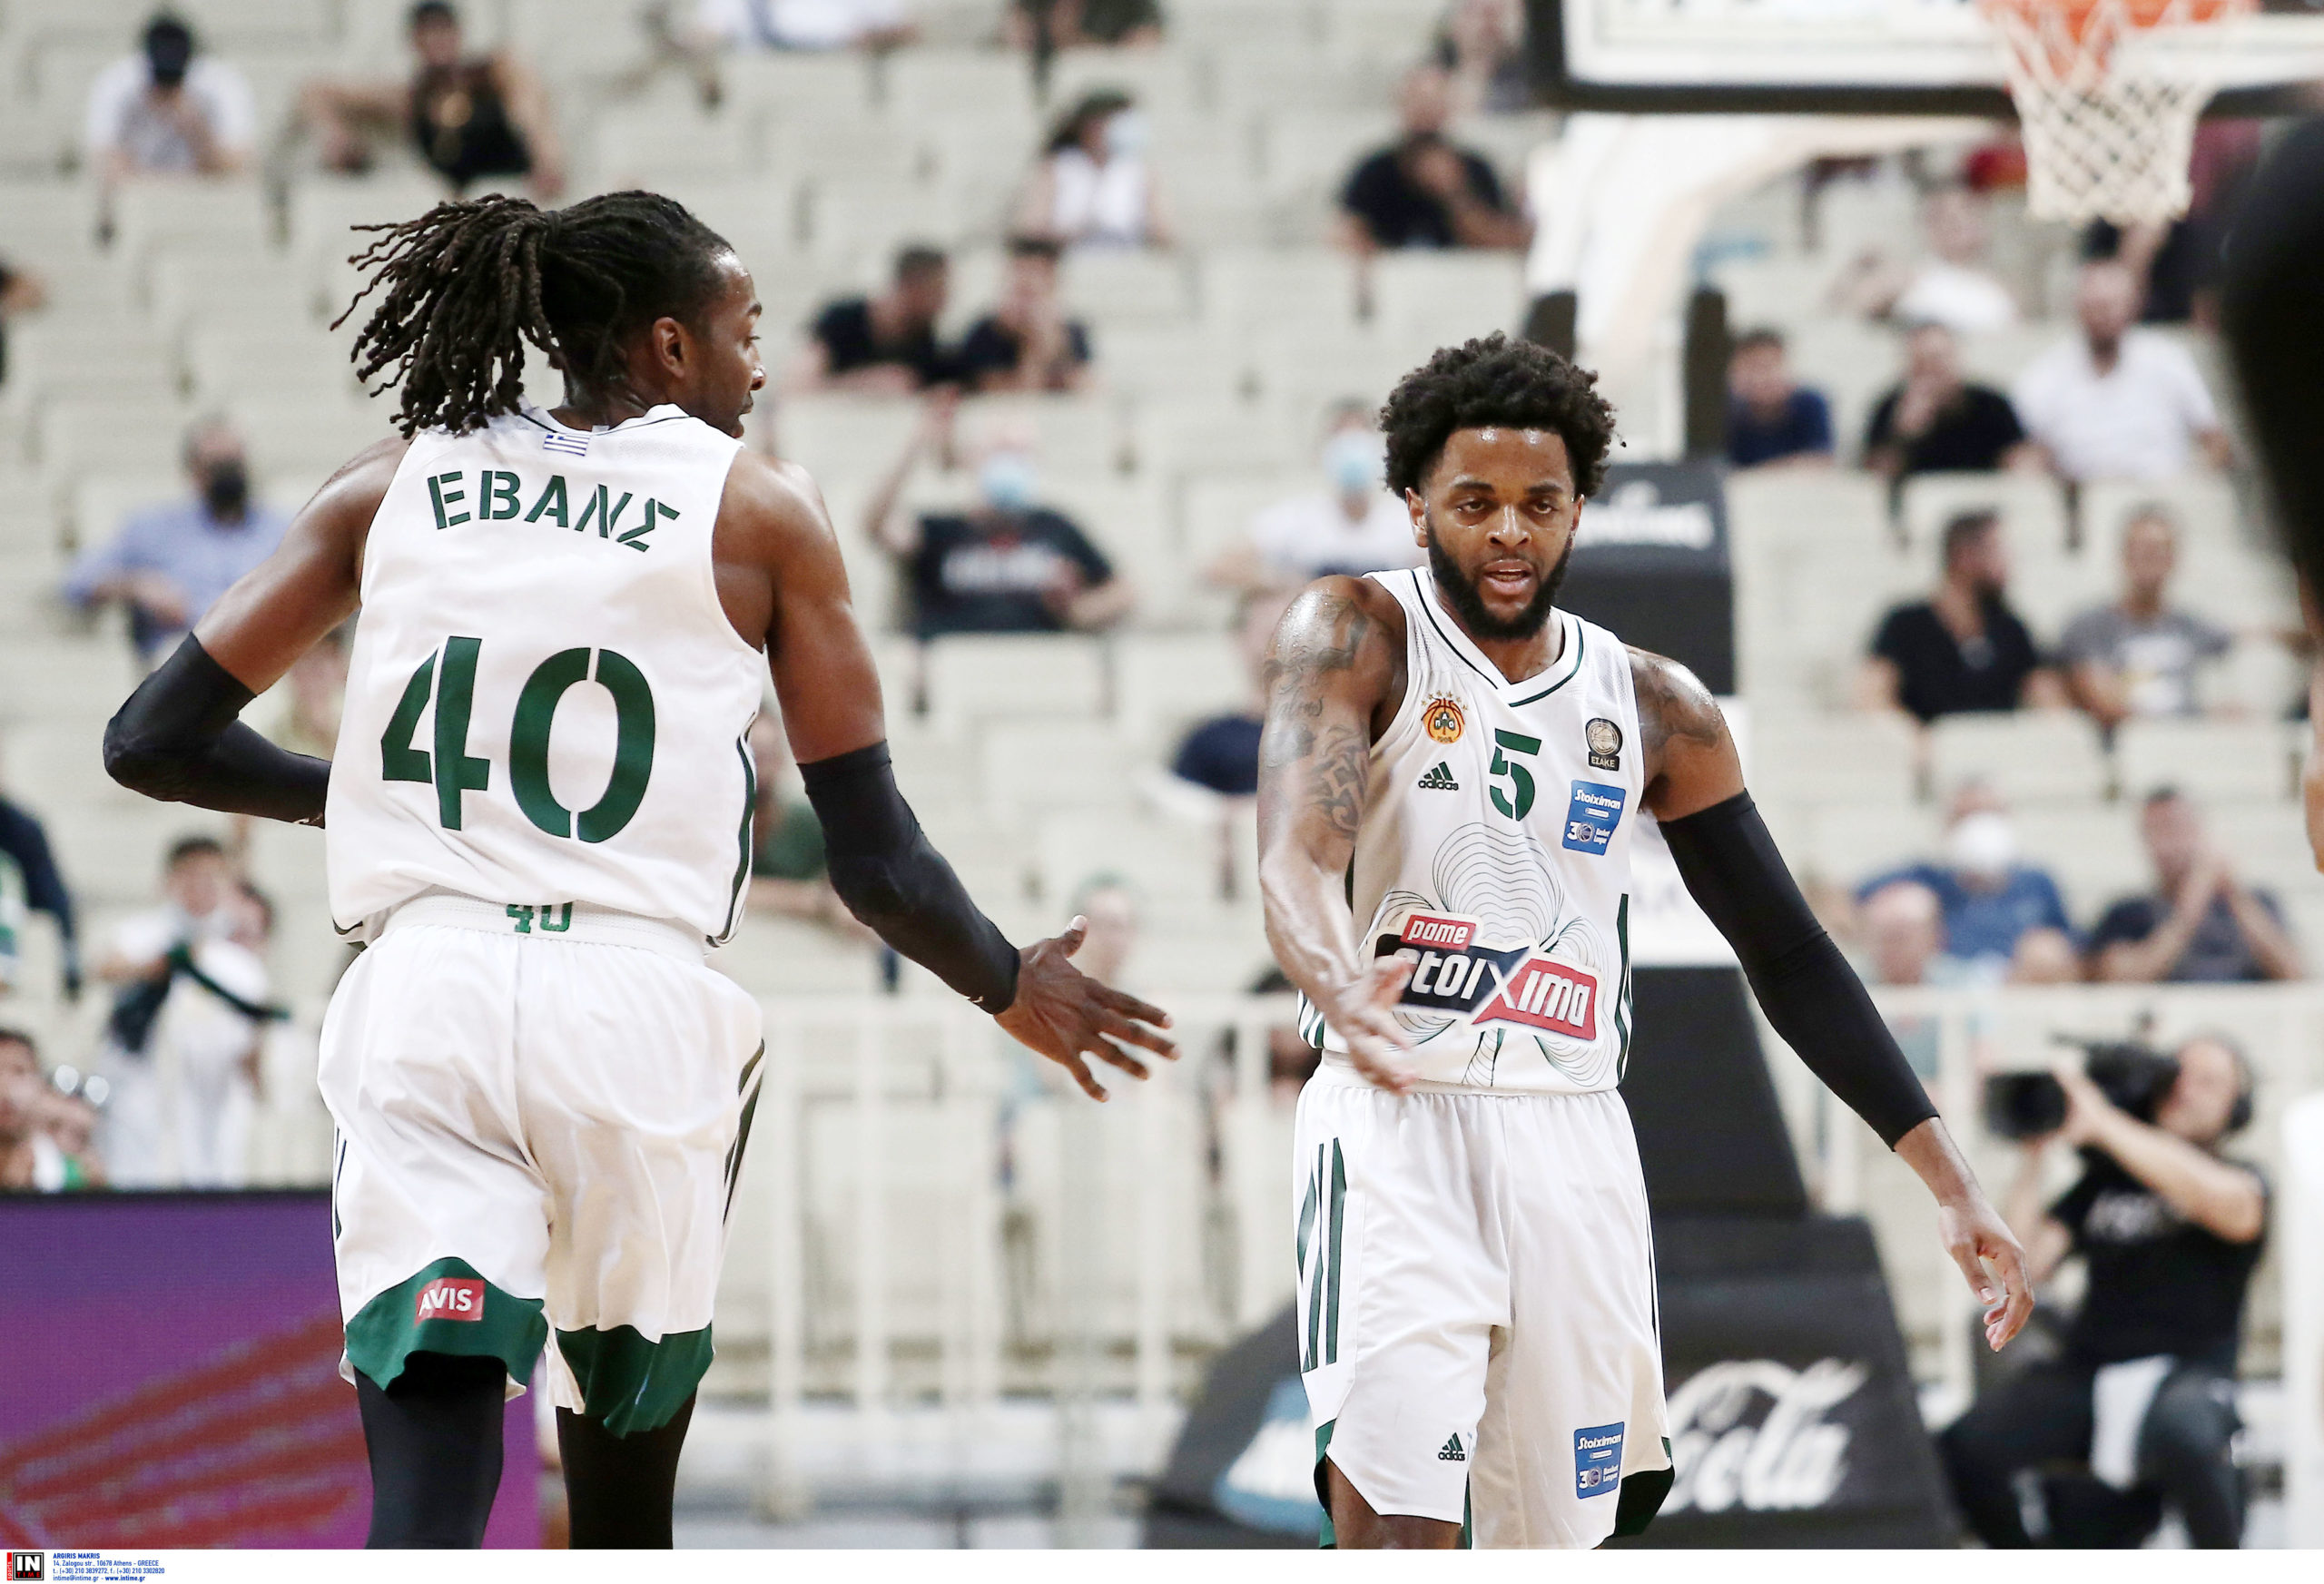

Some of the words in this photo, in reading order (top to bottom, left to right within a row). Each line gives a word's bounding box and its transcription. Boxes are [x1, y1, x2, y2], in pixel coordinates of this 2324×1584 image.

[427, 470, 680, 552] ΕΒΑΝΣ
[380, 635, 655, 843] 40
[1590, 756, 1615, 768] ΕΣΑΚΕ
[1418, 778, 1459, 791] adidas
[1489, 728, 1542, 822] 5
[1574, 789, 1621, 810] Stoiximan
[1407, 920, 1469, 945] pame
[419, 1287, 473, 1316] AVIS
[1577, 1433, 1622, 1451] Stoiximan
